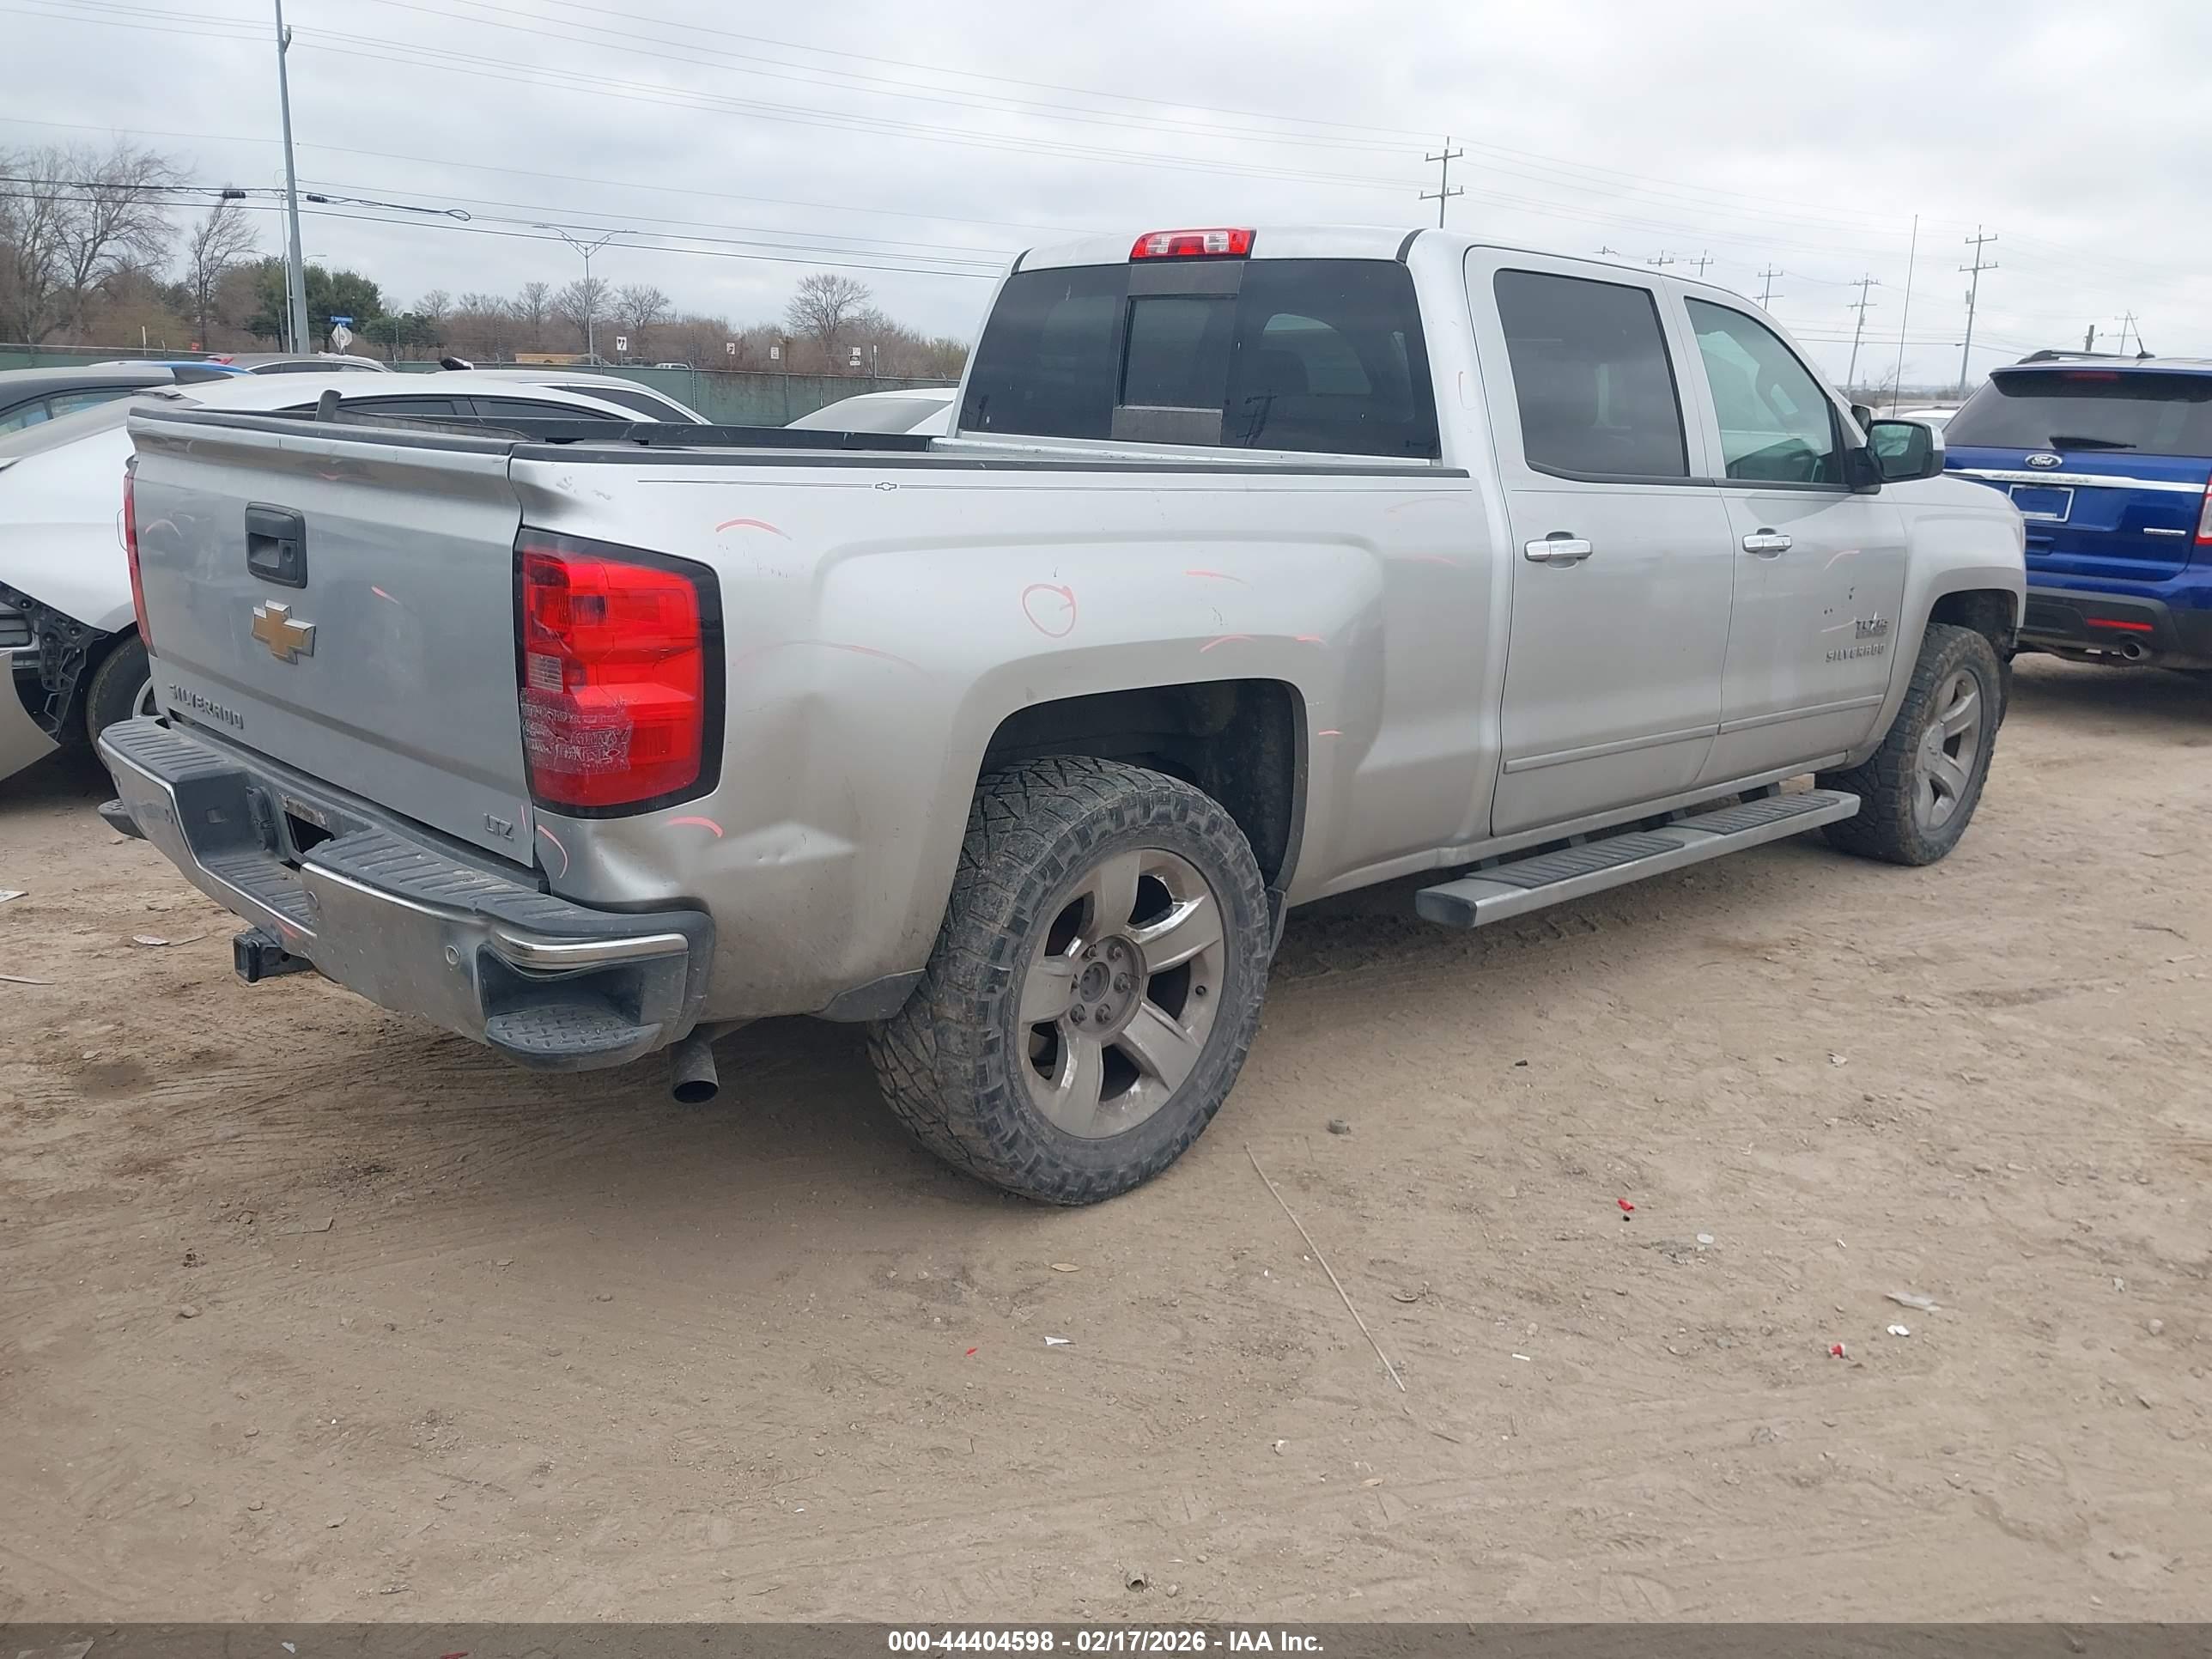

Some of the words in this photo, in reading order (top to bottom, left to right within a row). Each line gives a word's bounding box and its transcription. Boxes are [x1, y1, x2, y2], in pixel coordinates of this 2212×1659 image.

[2031, 456, 2054, 466] Ford
[1826, 644, 1884, 663] SILVERADO
[168, 683, 244, 730] SILVERADO
[483, 812, 514, 842] LTZ
